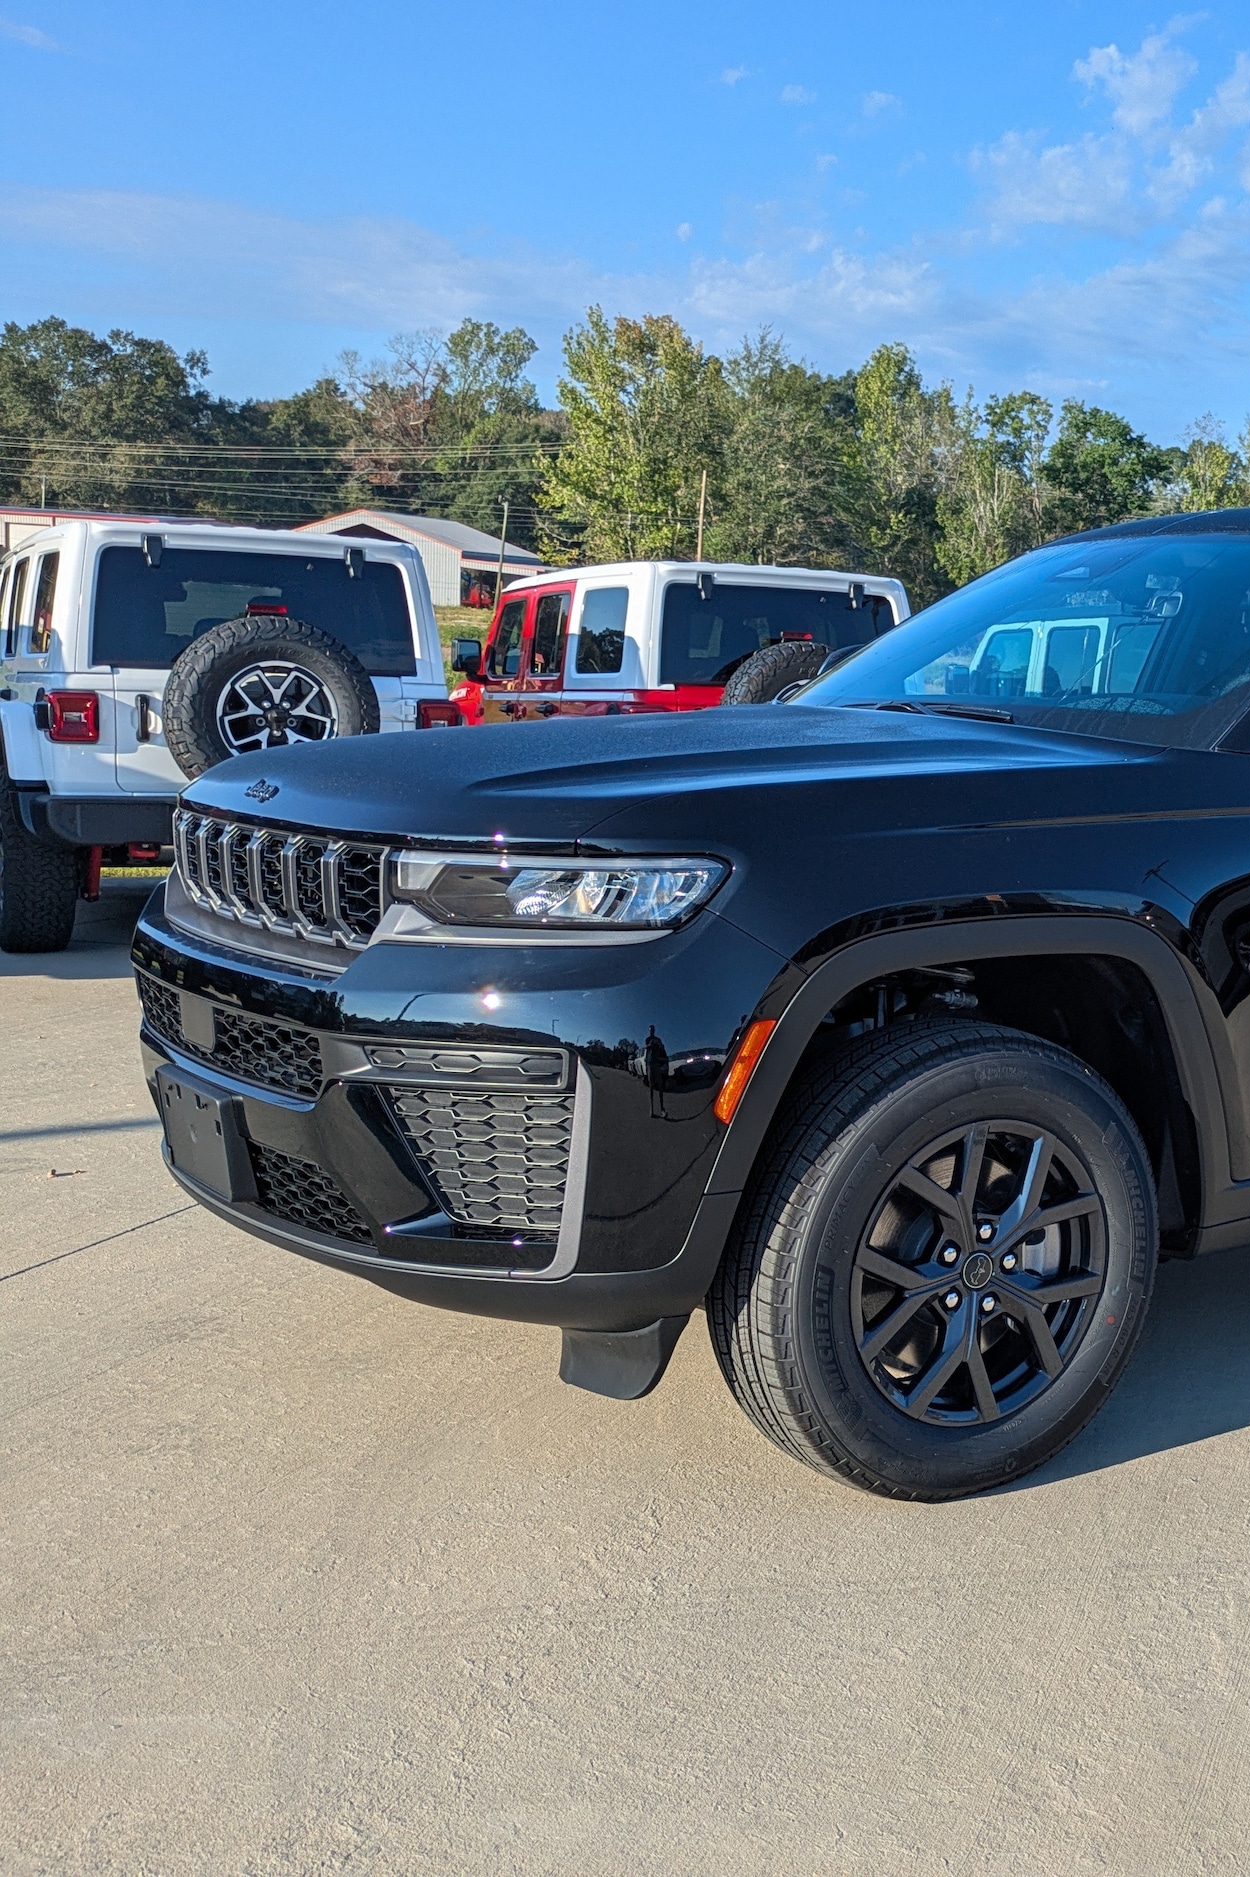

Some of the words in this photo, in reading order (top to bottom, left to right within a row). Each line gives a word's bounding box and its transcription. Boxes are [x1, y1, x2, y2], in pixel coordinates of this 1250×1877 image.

[823, 1180, 856, 1250] PRIMACY
[1123, 1169, 1145, 1277] MICHELIN
[815, 1271, 843, 1391] MICHELIN
